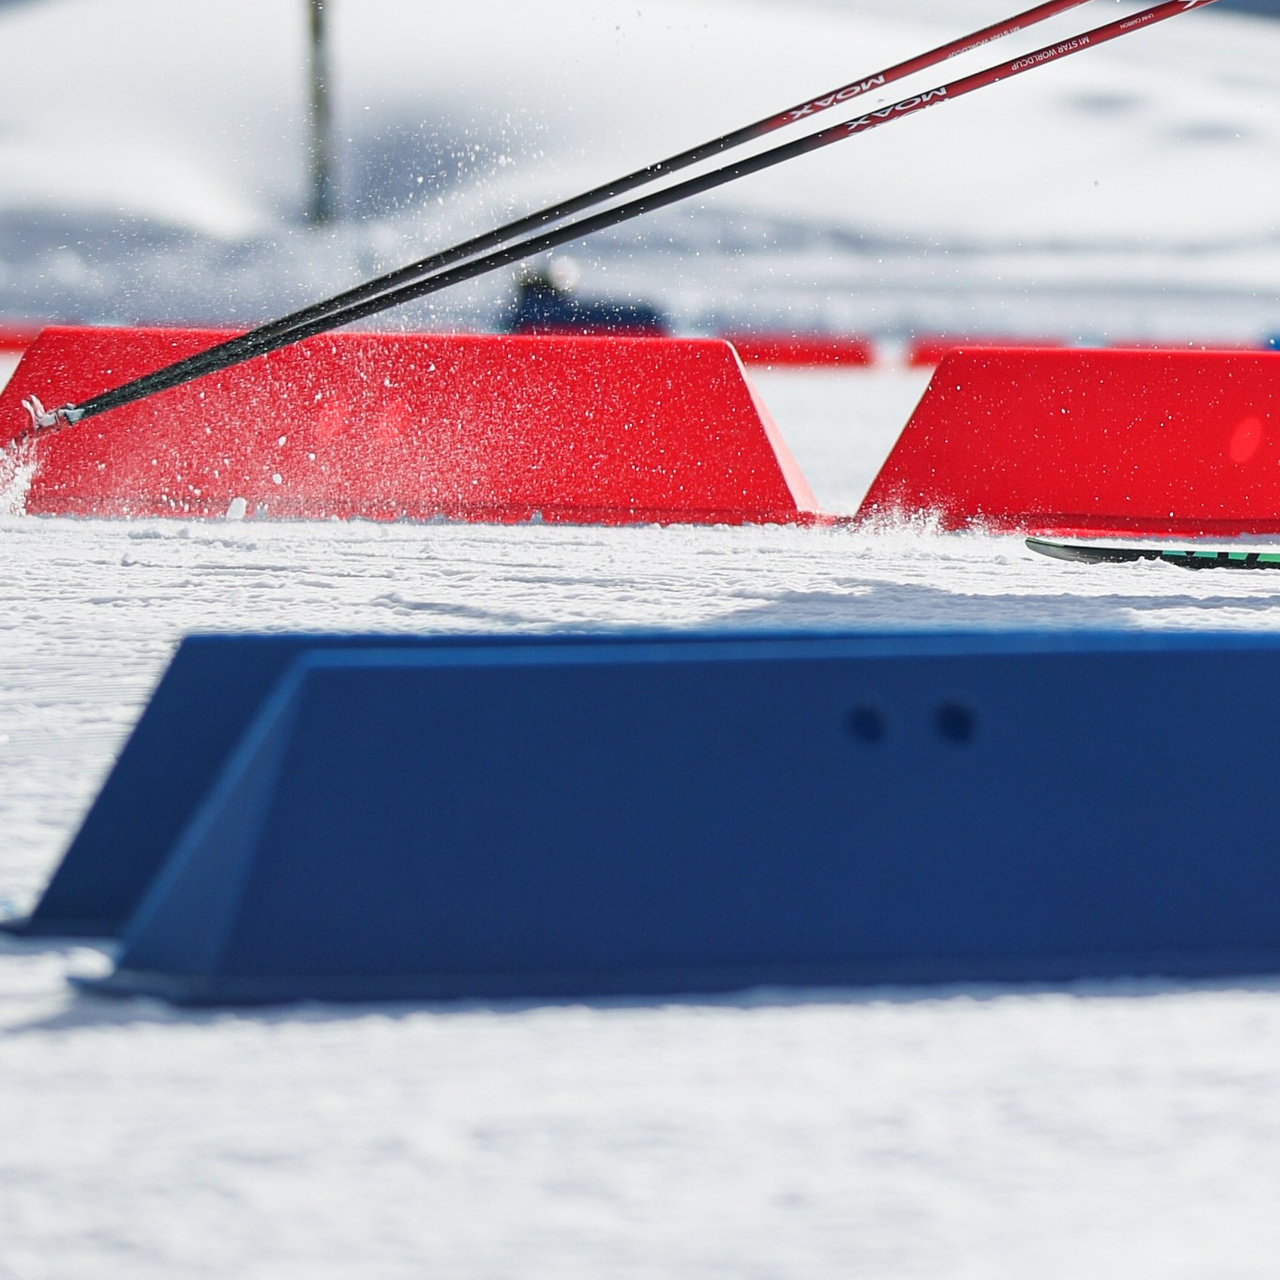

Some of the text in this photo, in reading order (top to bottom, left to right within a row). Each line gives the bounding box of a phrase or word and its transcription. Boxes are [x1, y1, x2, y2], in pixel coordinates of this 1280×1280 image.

[1011, 35, 1090, 71] M1 STAR WORLDCUP
[789, 75, 885, 119] MOAX
[845, 87, 947, 130] MOAX
